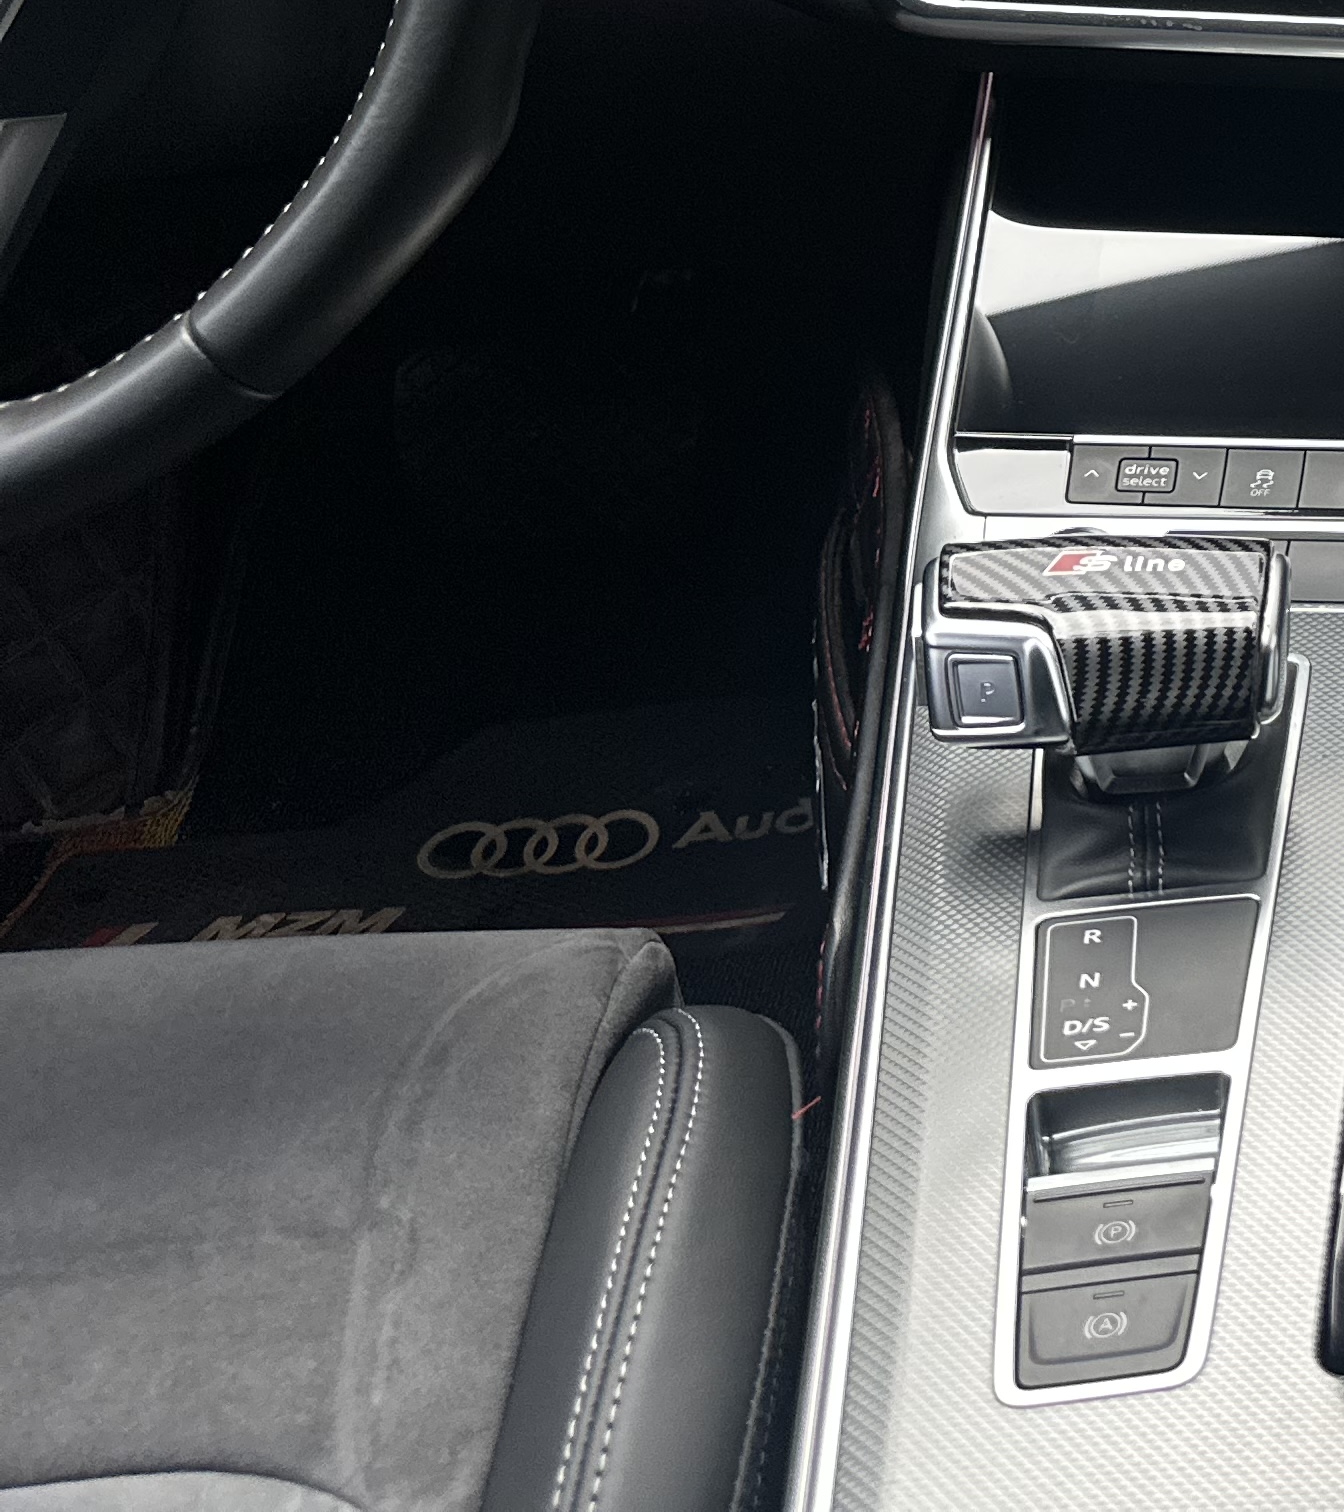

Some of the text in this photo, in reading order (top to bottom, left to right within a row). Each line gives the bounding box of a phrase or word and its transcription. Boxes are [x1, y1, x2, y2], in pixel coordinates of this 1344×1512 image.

[1124, 464, 1170, 475] drive
[1122, 476, 1168, 487] select
[1250, 488, 1271, 497] OFF
[1123, 555, 1186, 572] line
[672, 798, 814, 849] Aud
[1083, 929, 1102, 944] R
[1080, 972, 1100, 988] N
[1062, 1016, 1110, 1036] D/S
